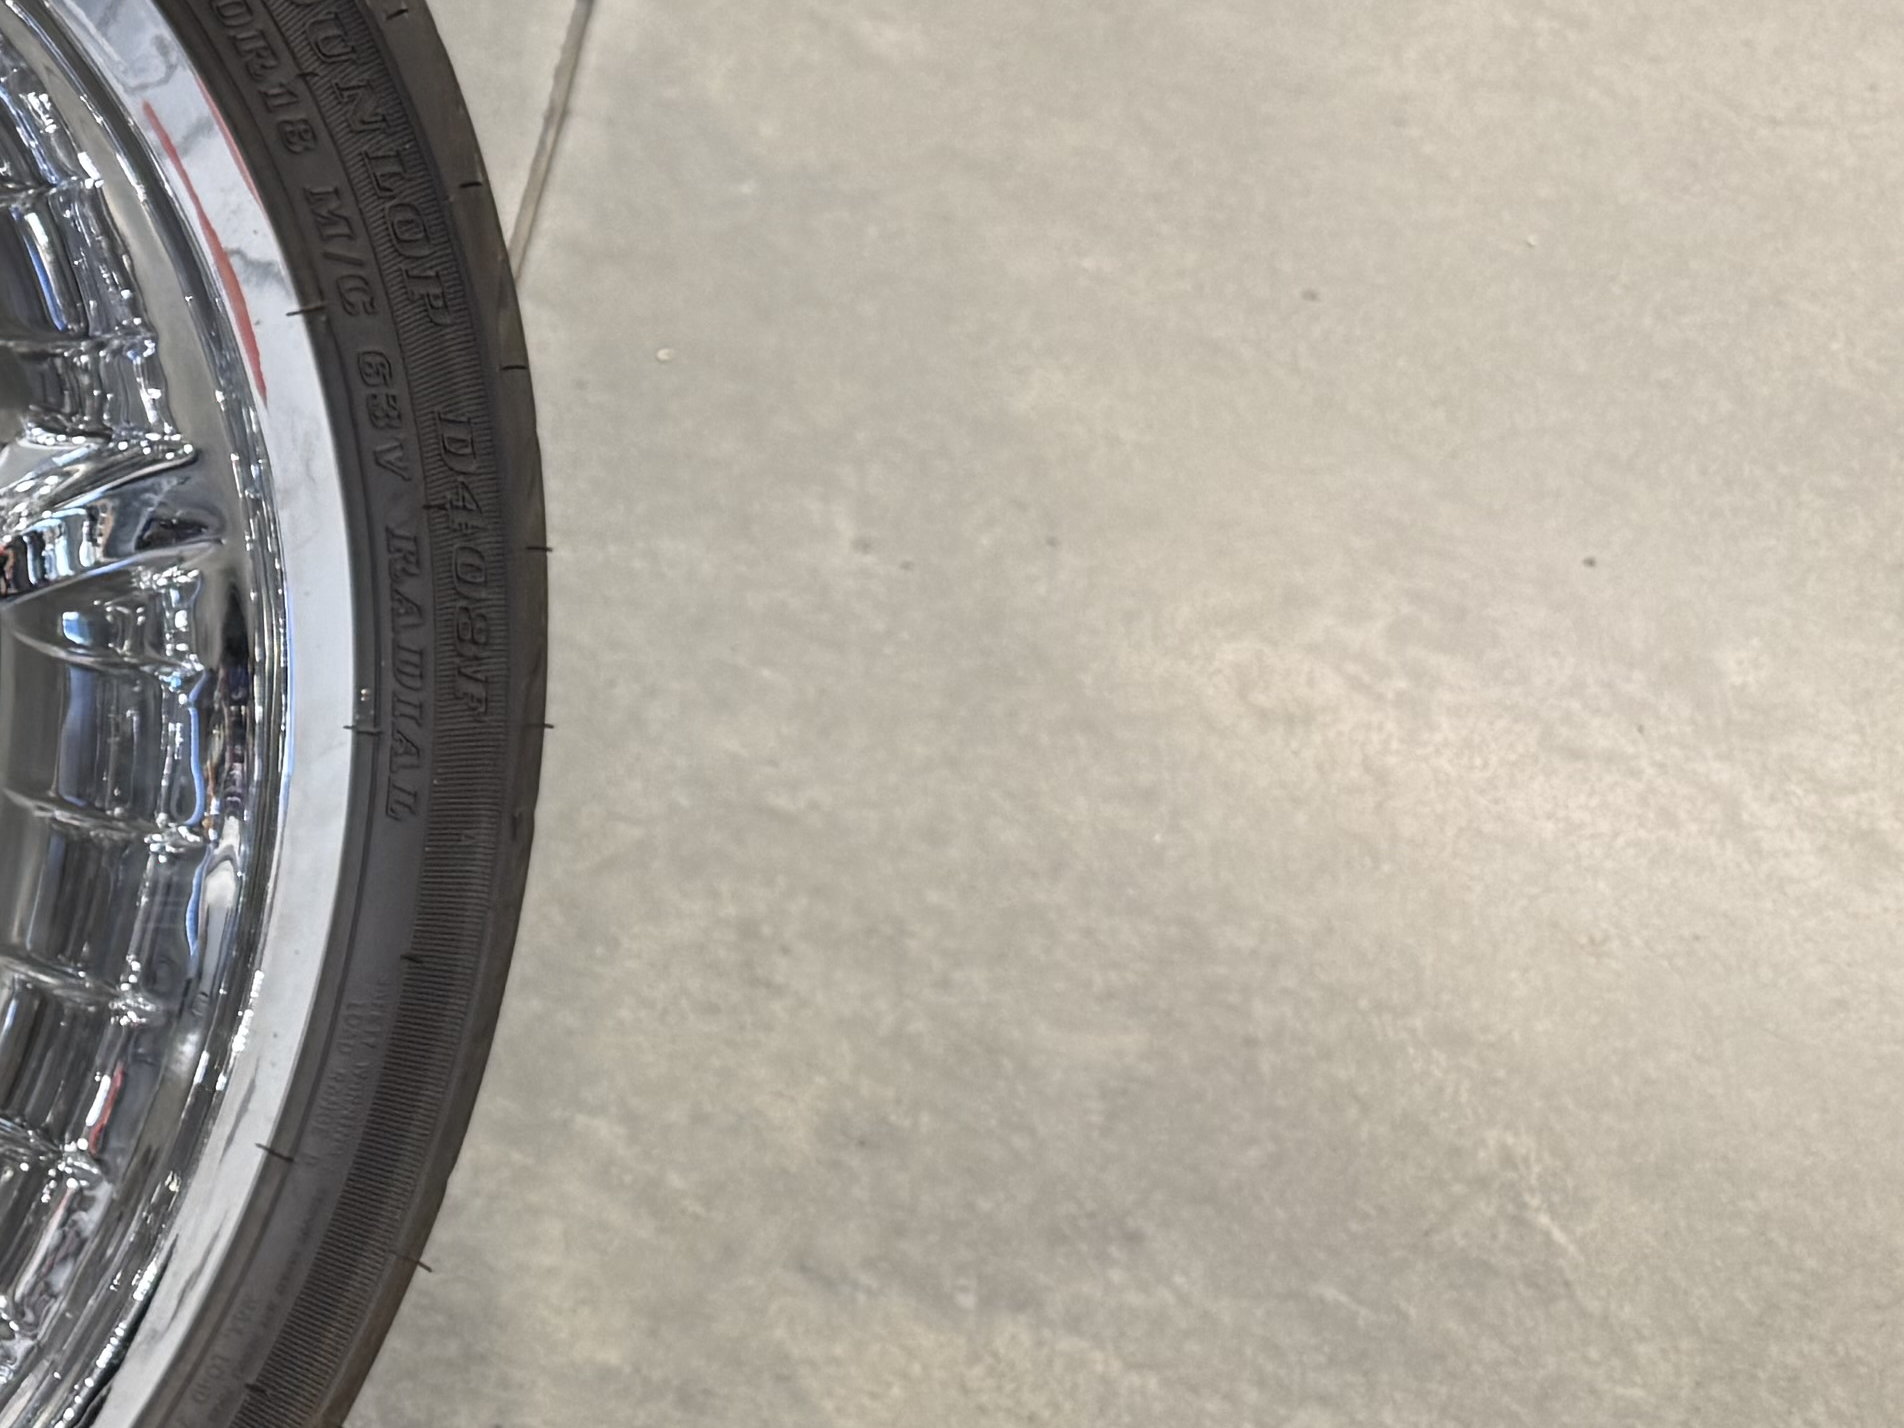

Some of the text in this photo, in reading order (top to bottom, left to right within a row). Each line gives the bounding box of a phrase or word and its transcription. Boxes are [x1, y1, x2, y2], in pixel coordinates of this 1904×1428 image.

[299, 170, 377, 326] M/C
[352, 340, 411, 488] 63V
[432, 398, 489, 719] D408F
[381, 516, 424, 821] RADIAL
[332, 998, 369, 1058] LOAD
[187, 1352, 232, 1408] LOAD
